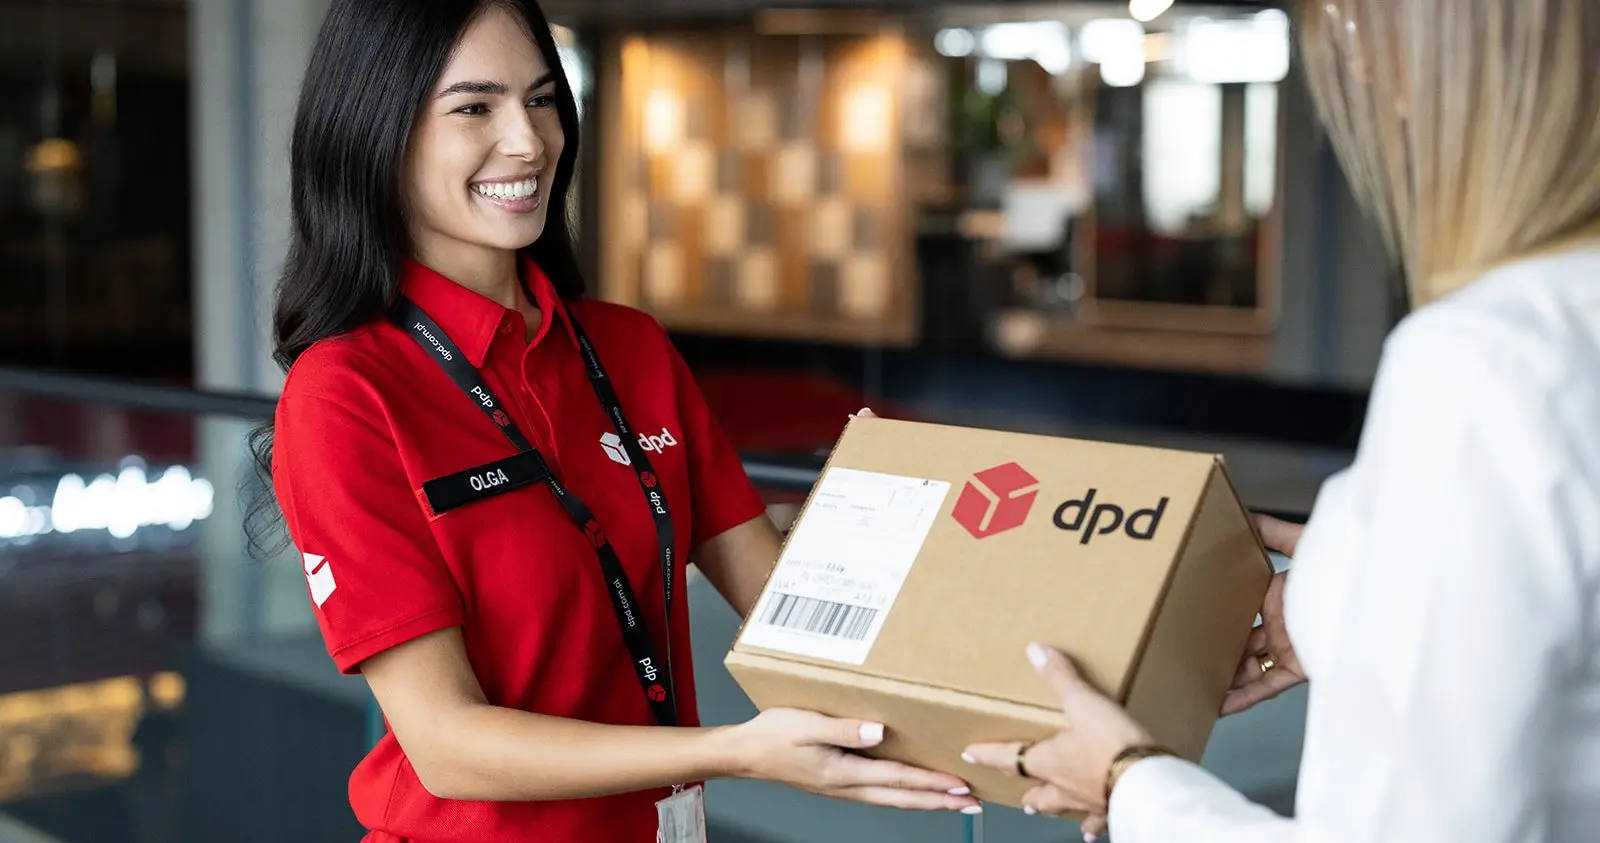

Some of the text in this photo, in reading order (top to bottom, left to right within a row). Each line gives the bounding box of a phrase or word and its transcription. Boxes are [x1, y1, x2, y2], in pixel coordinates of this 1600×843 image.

[413, 321, 453, 362] dpd.com.pl
[470, 385, 494, 408] dpd
[637, 427, 677, 455] dpd
[469, 467, 510, 492] OLGA
[649, 491, 667, 514] dpd
[1053, 488, 1169, 545] dpd
[613, 578, 636, 627] dpd.com.pl
[638, 656, 658, 681] dpd
